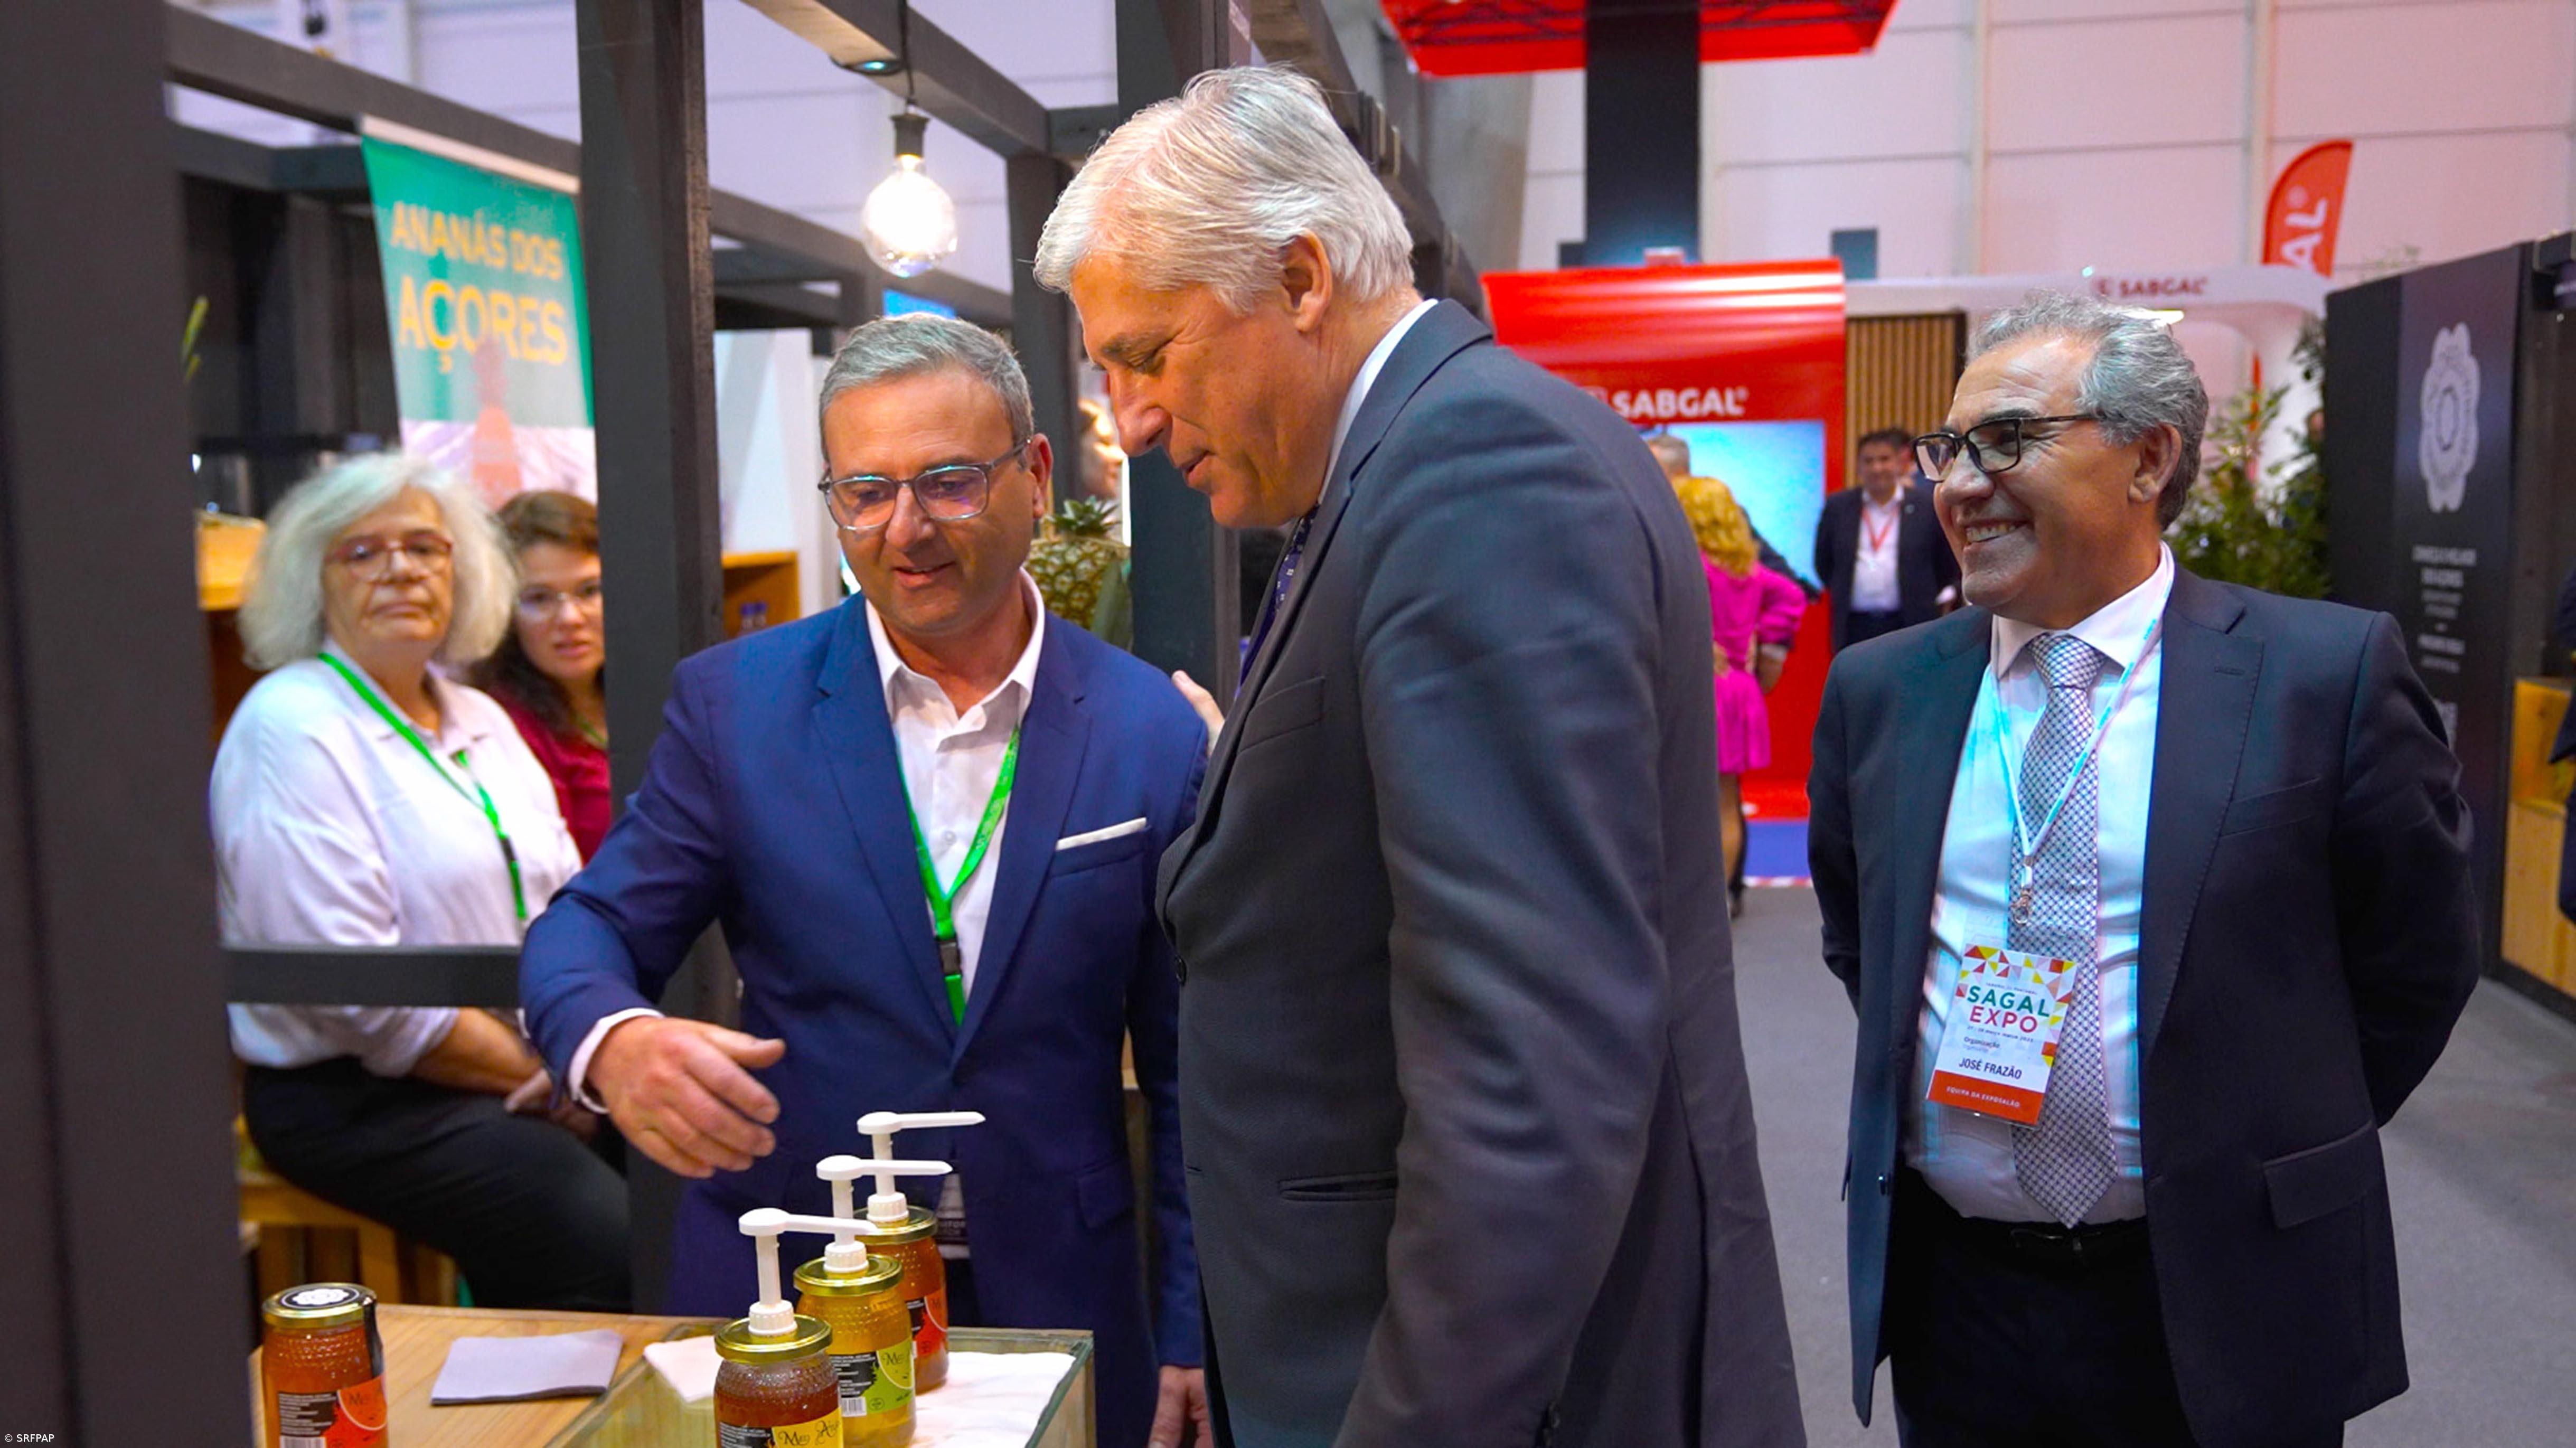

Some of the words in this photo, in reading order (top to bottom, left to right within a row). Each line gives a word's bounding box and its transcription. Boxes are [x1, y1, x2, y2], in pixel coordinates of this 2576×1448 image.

[390, 201, 507, 268] ANANÁS
[510, 228, 565, 281] DOS
[399, 275, 568, 373] AÇORES
[1967, 985, 2049, 1017] SAGAL
[1970, 1005, 2037, 1033] EXPO
[1964, 1037, 2000, 1048] Organização
[1959, 1058, 1982, 1071] JOSÉ
[1983, 1063, 2022, 1079] FRAZÃO
[1947, 1086, 1970, 1097] EQUIPA
[1971, 1090, 1980, 1099] DA
